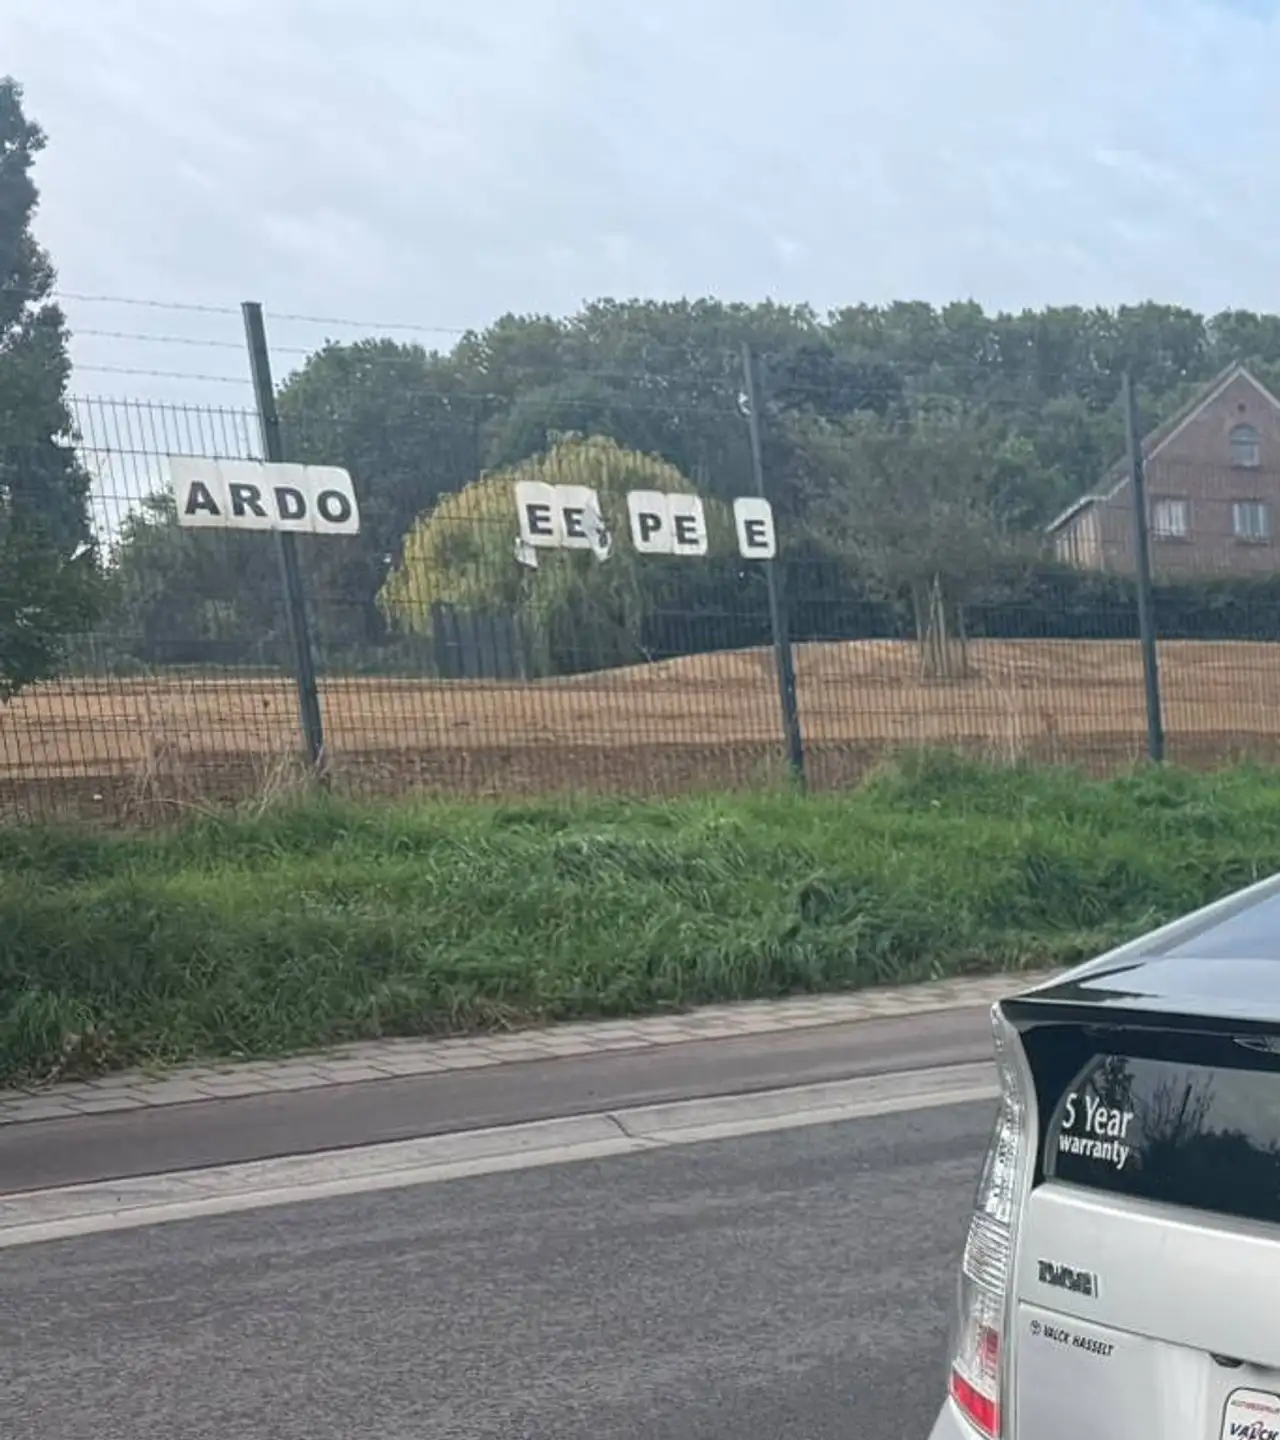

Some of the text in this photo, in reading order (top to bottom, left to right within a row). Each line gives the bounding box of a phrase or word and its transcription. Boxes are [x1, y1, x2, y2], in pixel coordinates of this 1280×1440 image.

[184, 480, 351, 523] ARDO
[638, 512, 699, 545] PE
[744, 519, 768, 548] E
[1062, 1092, 1134, 1138] 5 Year
[1059, 1135, 1130, 1170] warranty
